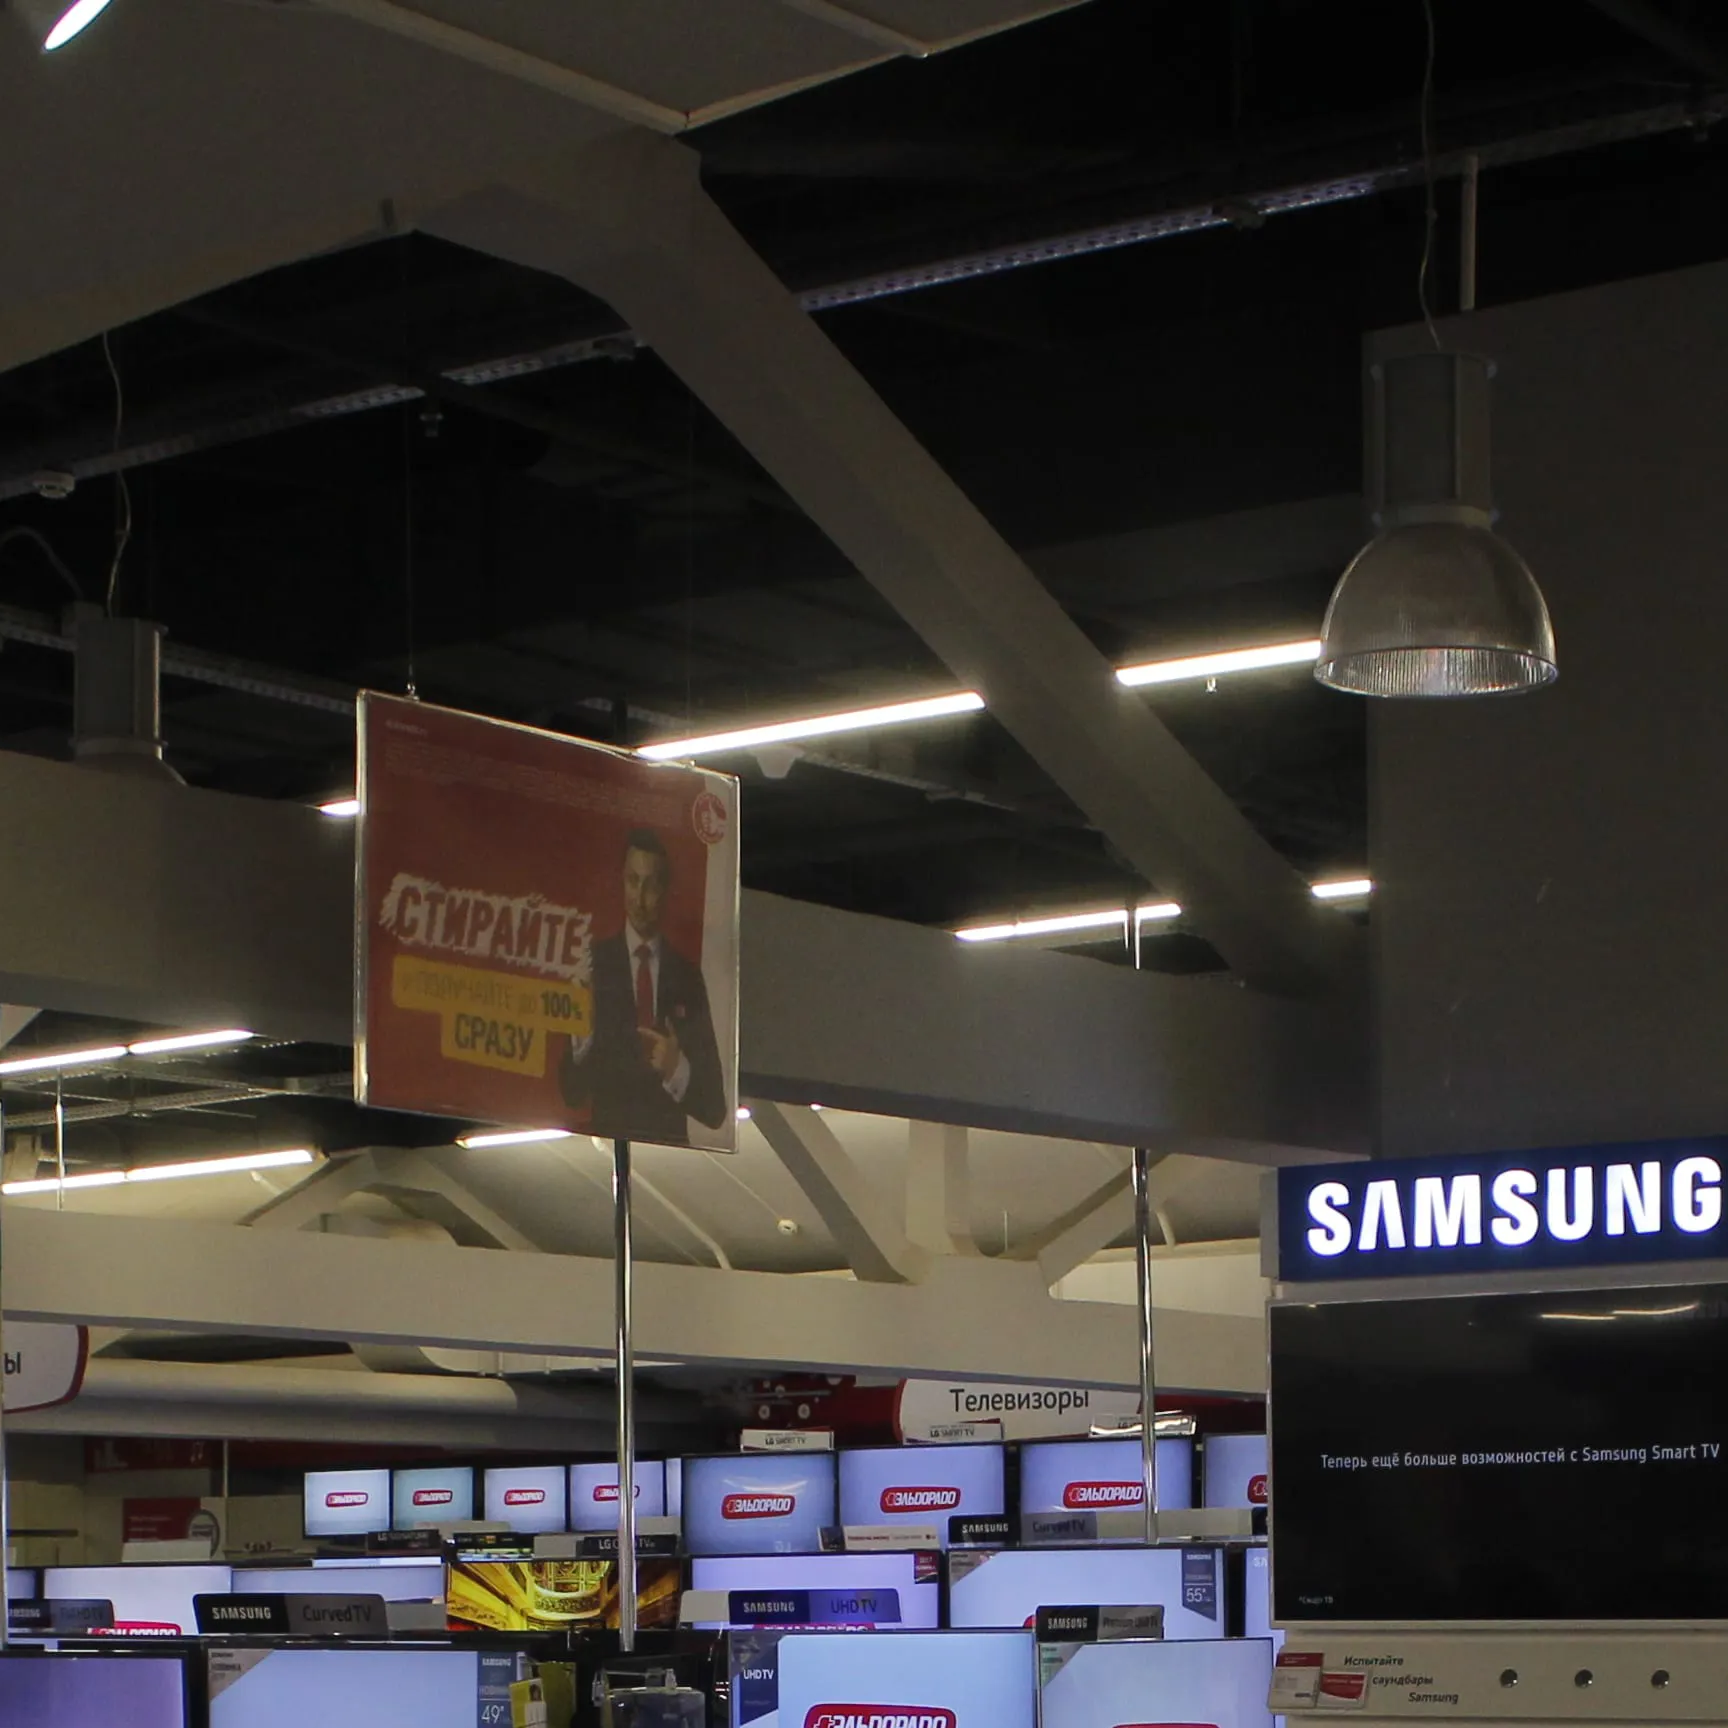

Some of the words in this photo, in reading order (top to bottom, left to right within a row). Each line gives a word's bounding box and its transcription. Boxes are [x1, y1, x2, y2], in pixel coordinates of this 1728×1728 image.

[394, 886, 584, 966] СТИРАЙТЕ
[454, 1013, 534, 1063] СРАЗУ
[1306, 1156, 1724, 1257] SAMSUNG
[950, 1388, 1090, 1415] Телевизоры
[1321, 1453, 1368, 1469] Теперь
[1372, 1452, 1400, 1467] ещё
[1404, 1451, 1457, 1467] больше
[1462, 1448, 1565, 1465] возможностей
[1582, 1446, 1647, 1464] Samsung
[1652, 1444, 1697, 1460] Smart
[1701, 1443, 1721, 1458] TV
[962, 1523, 1010, 1534] SAMSUNG
[212, 1606, 273, 1621] SAMSUNG
[743, 1601, 796, 1614] SAMSUNG
[1048, 1617, 1089, 1630] SAMSUNG
[1344, 1654, 1405, 1667] Испытайте
[743, 1668, 762, 1681] UHD
[1372, 1674, 1434, 1687] саундбары
[1408, 1691, 1460, 1705] Samsung
